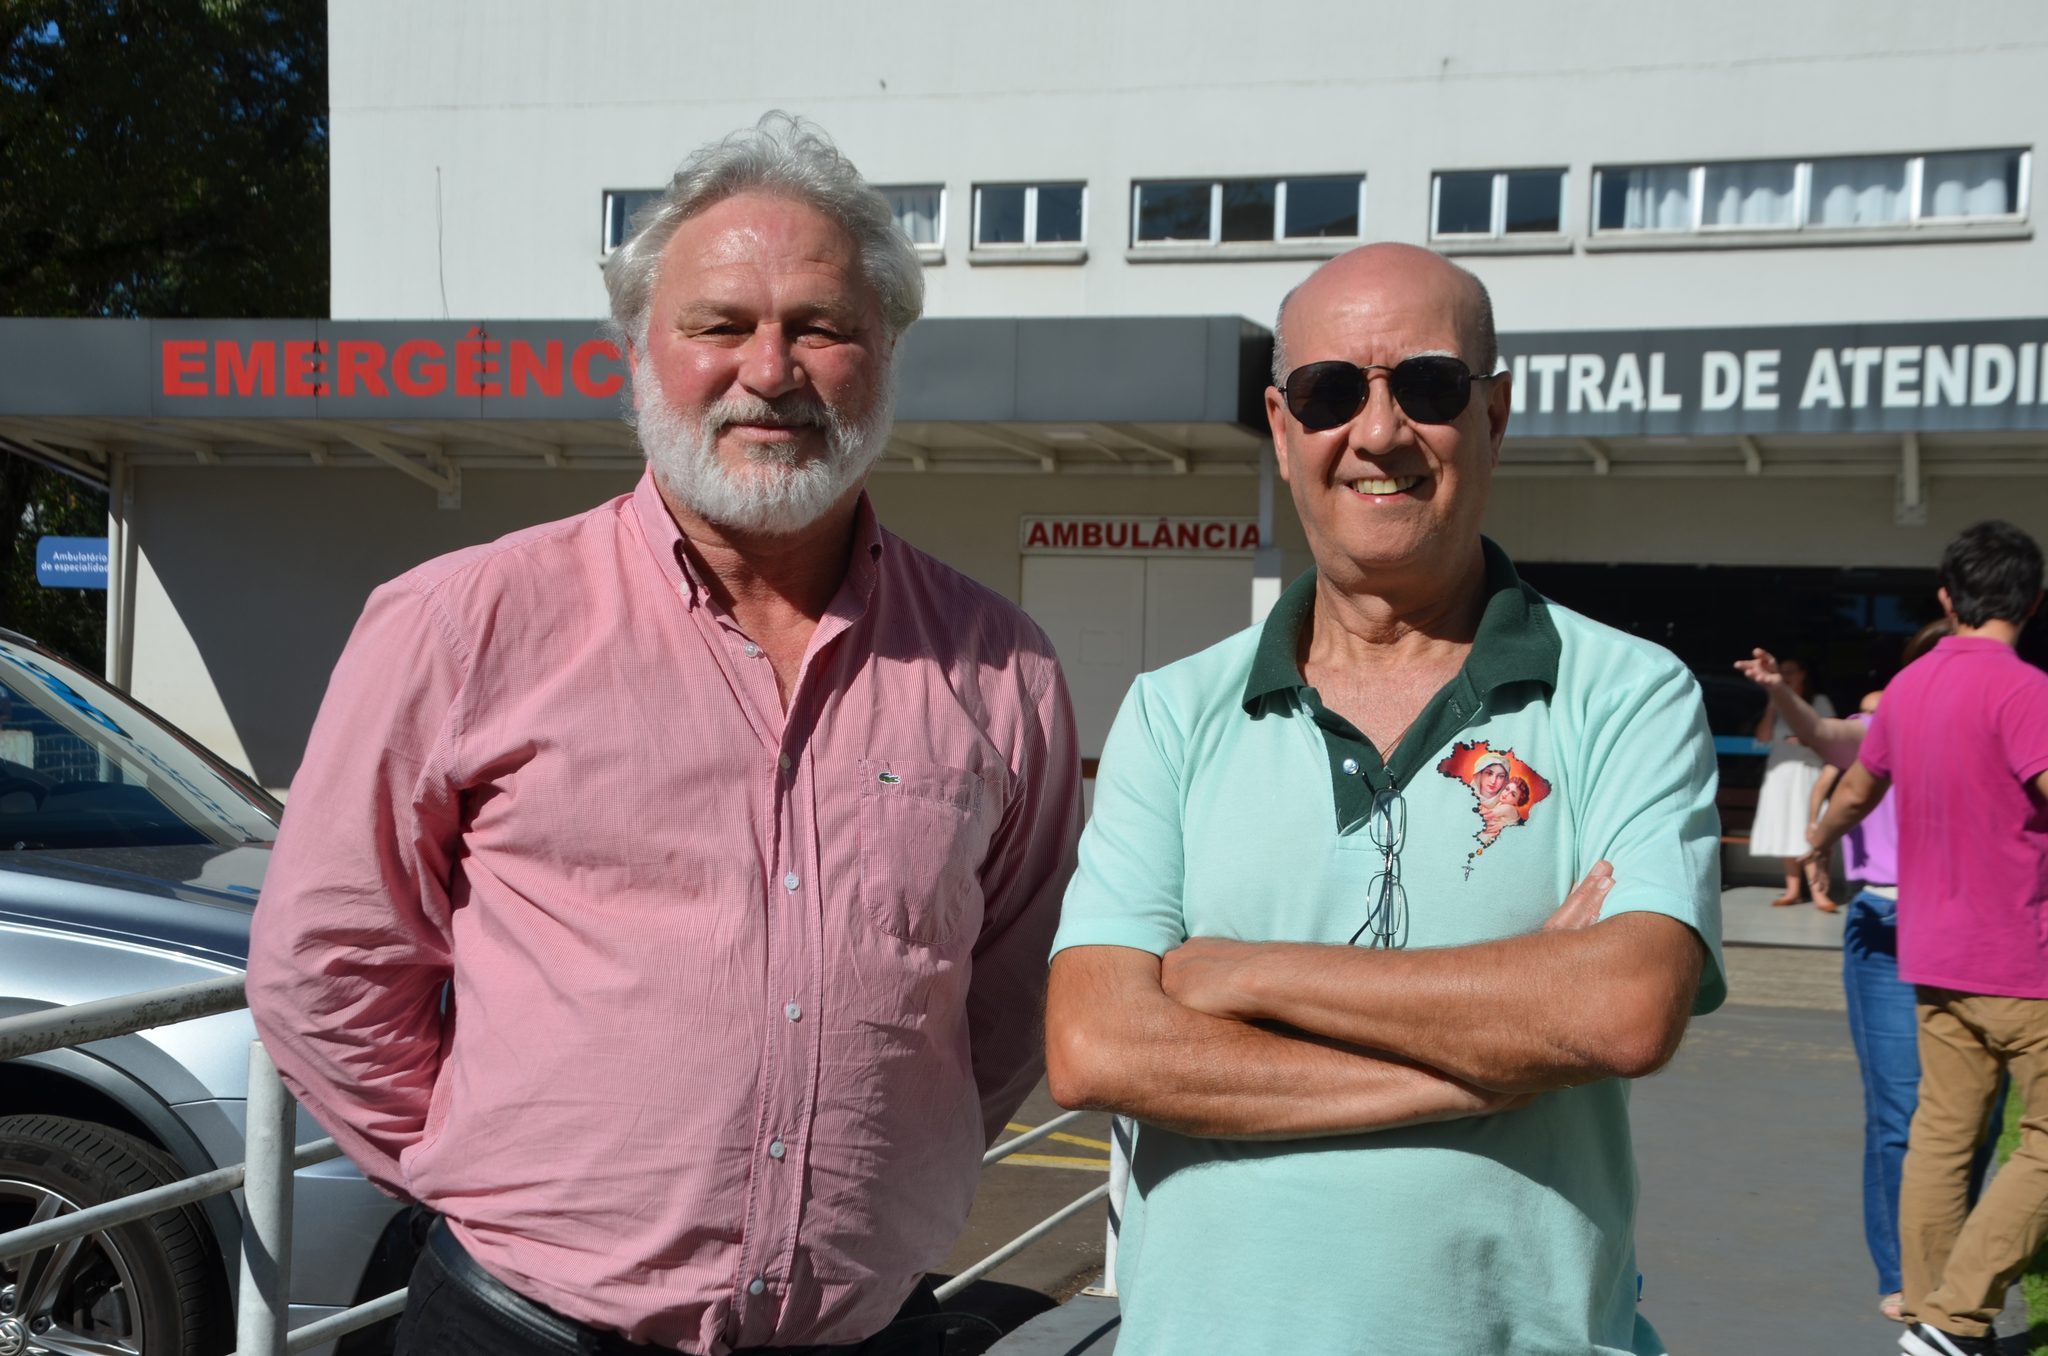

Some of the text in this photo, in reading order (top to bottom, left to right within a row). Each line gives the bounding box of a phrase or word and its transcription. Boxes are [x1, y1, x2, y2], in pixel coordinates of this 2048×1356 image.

[162, 325, 625, 398] EMERGÊNC
[1701, 350, 1781, 411] DE
[1799, 342, 2048, 408] ATENDI
[1027, 517, 1260, 548] AMBULÂNCIA
[41, 561, 52, 571] de
[53, 551, 108, 562] Ambulatório
